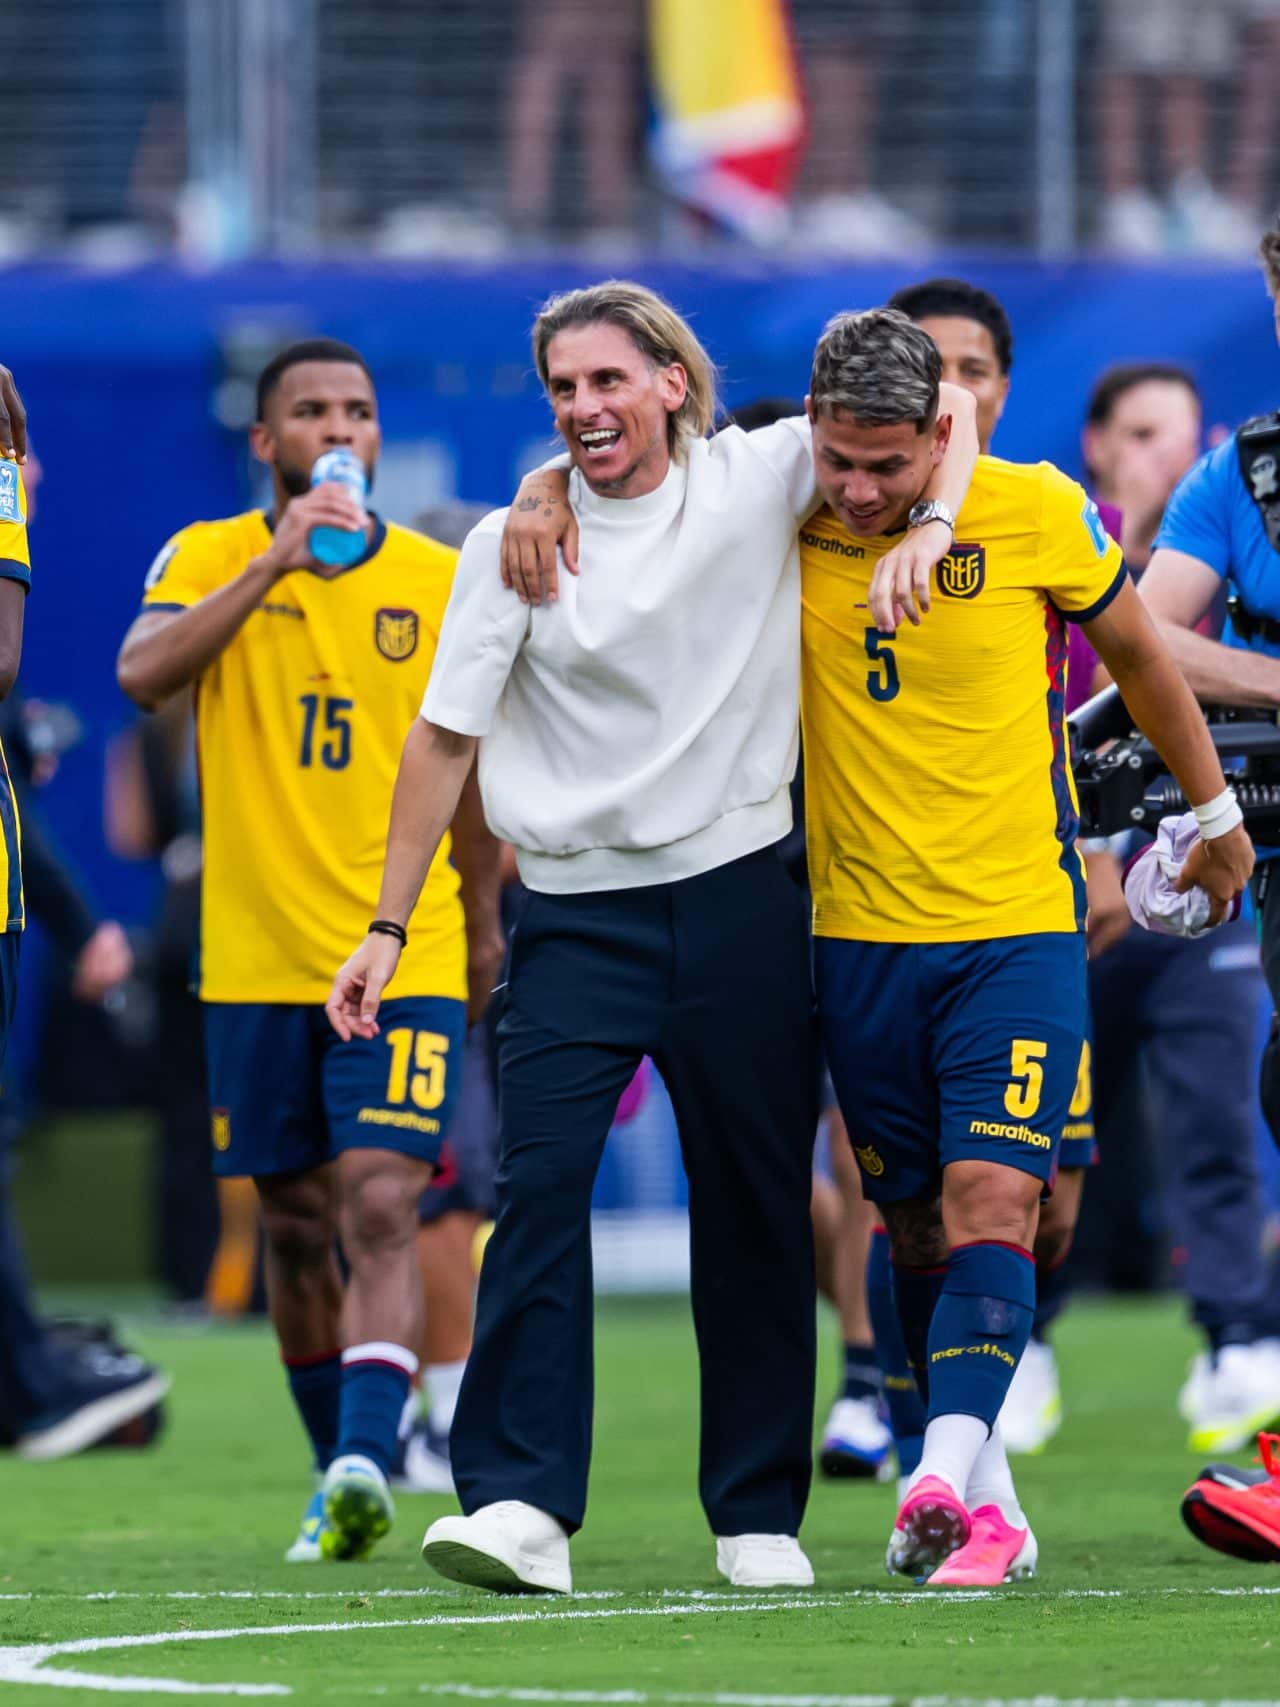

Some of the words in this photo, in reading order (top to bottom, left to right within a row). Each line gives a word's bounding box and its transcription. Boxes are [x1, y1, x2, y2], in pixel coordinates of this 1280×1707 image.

[864, 627, 900, 702] 5
[299, 693, 353, 771] 15
[386, 1027, 449, 1110] 15
[1004, 1039, 1047, 1118] 5
[969, 1120, 1051, 1149] marathon
[931, 1343, 1015, 1367] marathon
